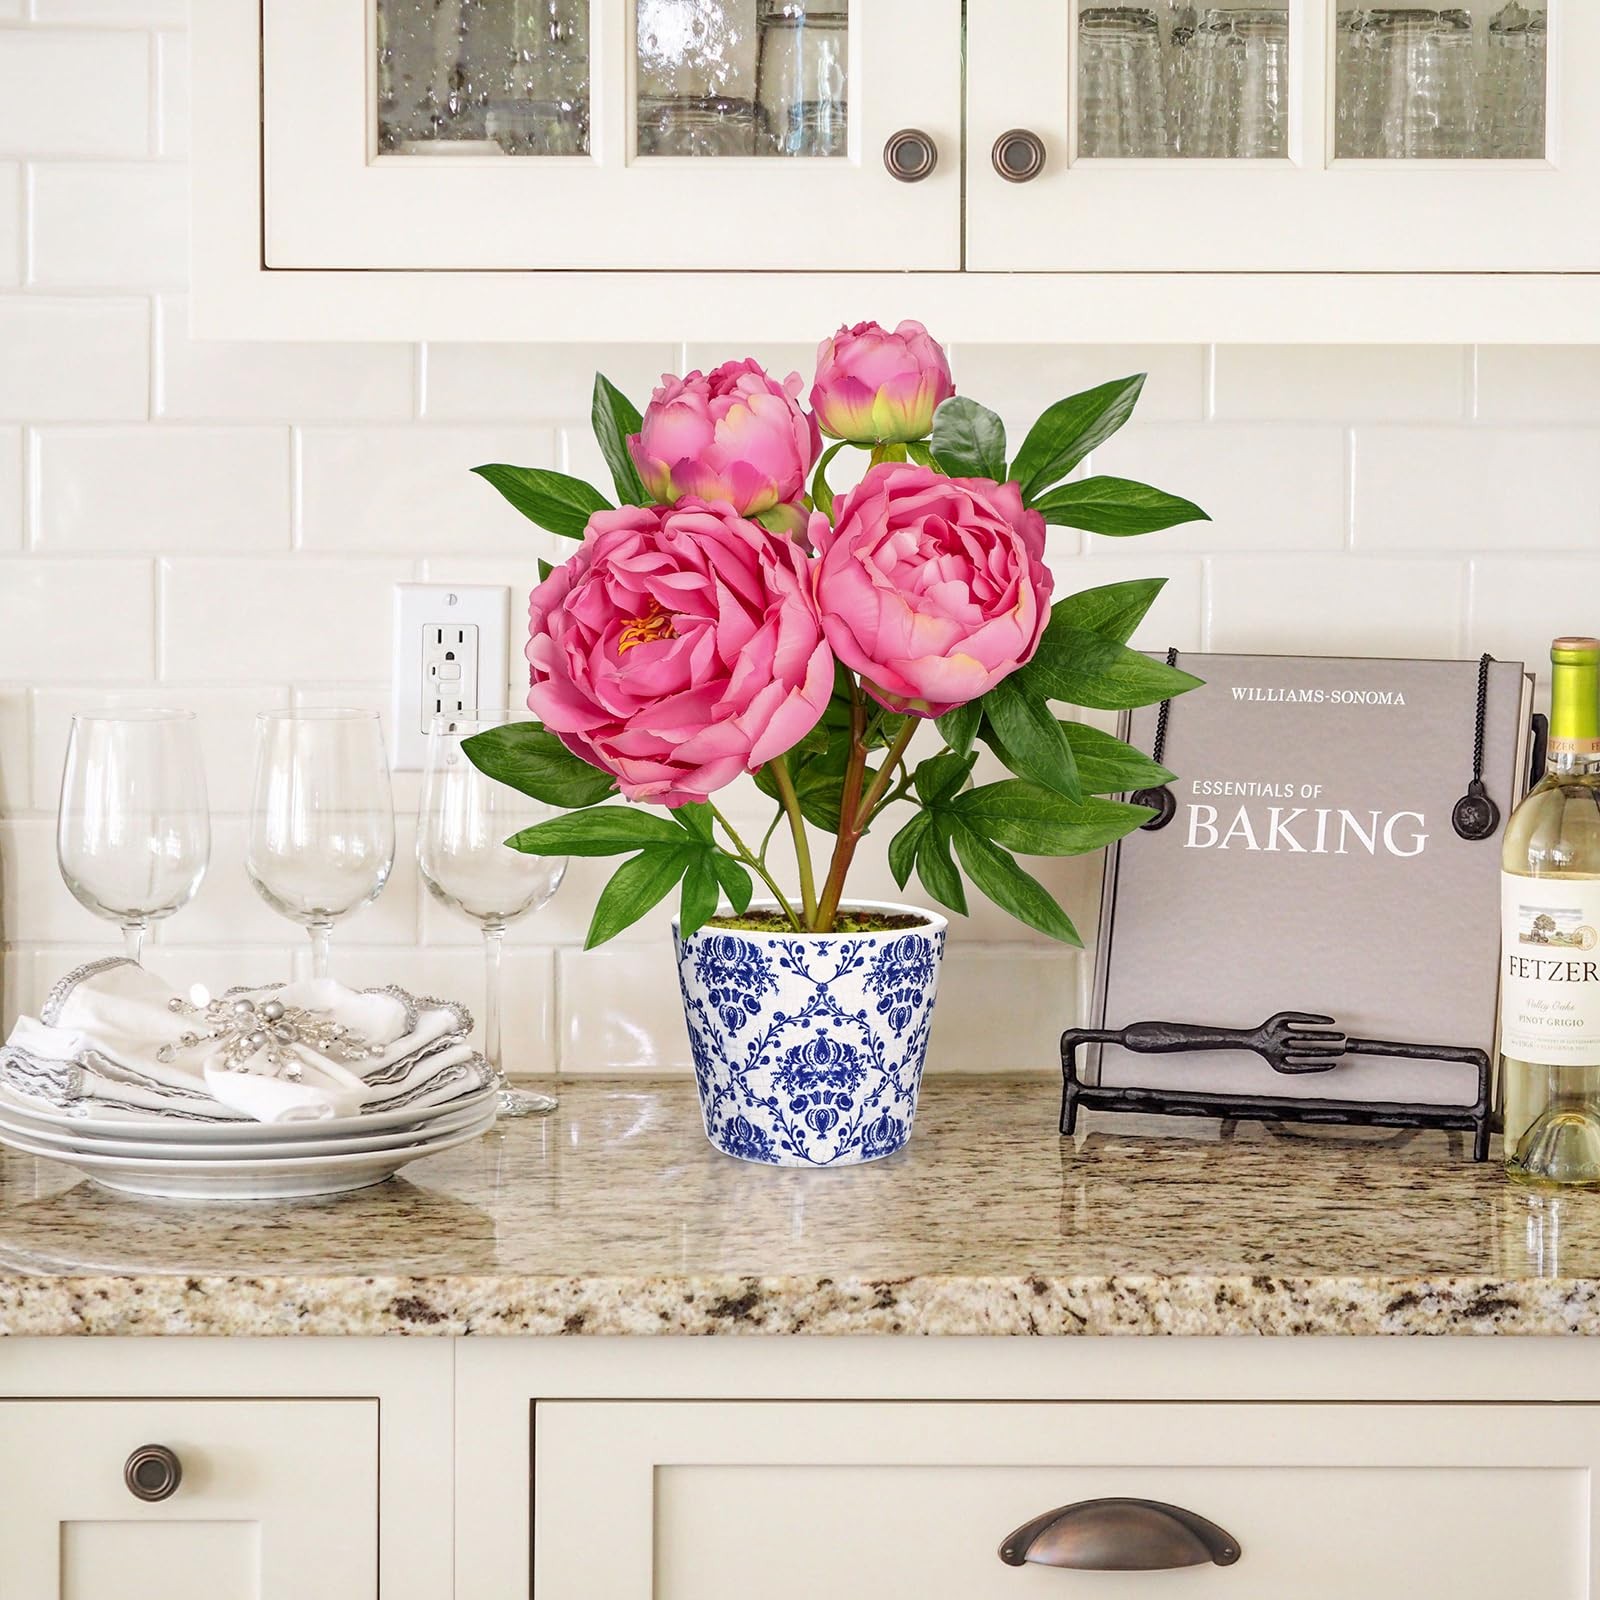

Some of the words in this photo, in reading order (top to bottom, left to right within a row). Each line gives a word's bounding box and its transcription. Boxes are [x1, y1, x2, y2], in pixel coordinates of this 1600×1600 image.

[1231, 686, 1407, 706] WILLIAMS-SONOMA
[1192, 780, 1294, 799] ESSENTIALS
[1300, 783, 1323, 799] OF
[1184, 803, 1430, 857] BAKING
[1509, 955, 1600, 983] FETZER
[1519, 1014, 1545, 1026] PINOT
[1546, 1017, 1585, 1028] GRIGIO
